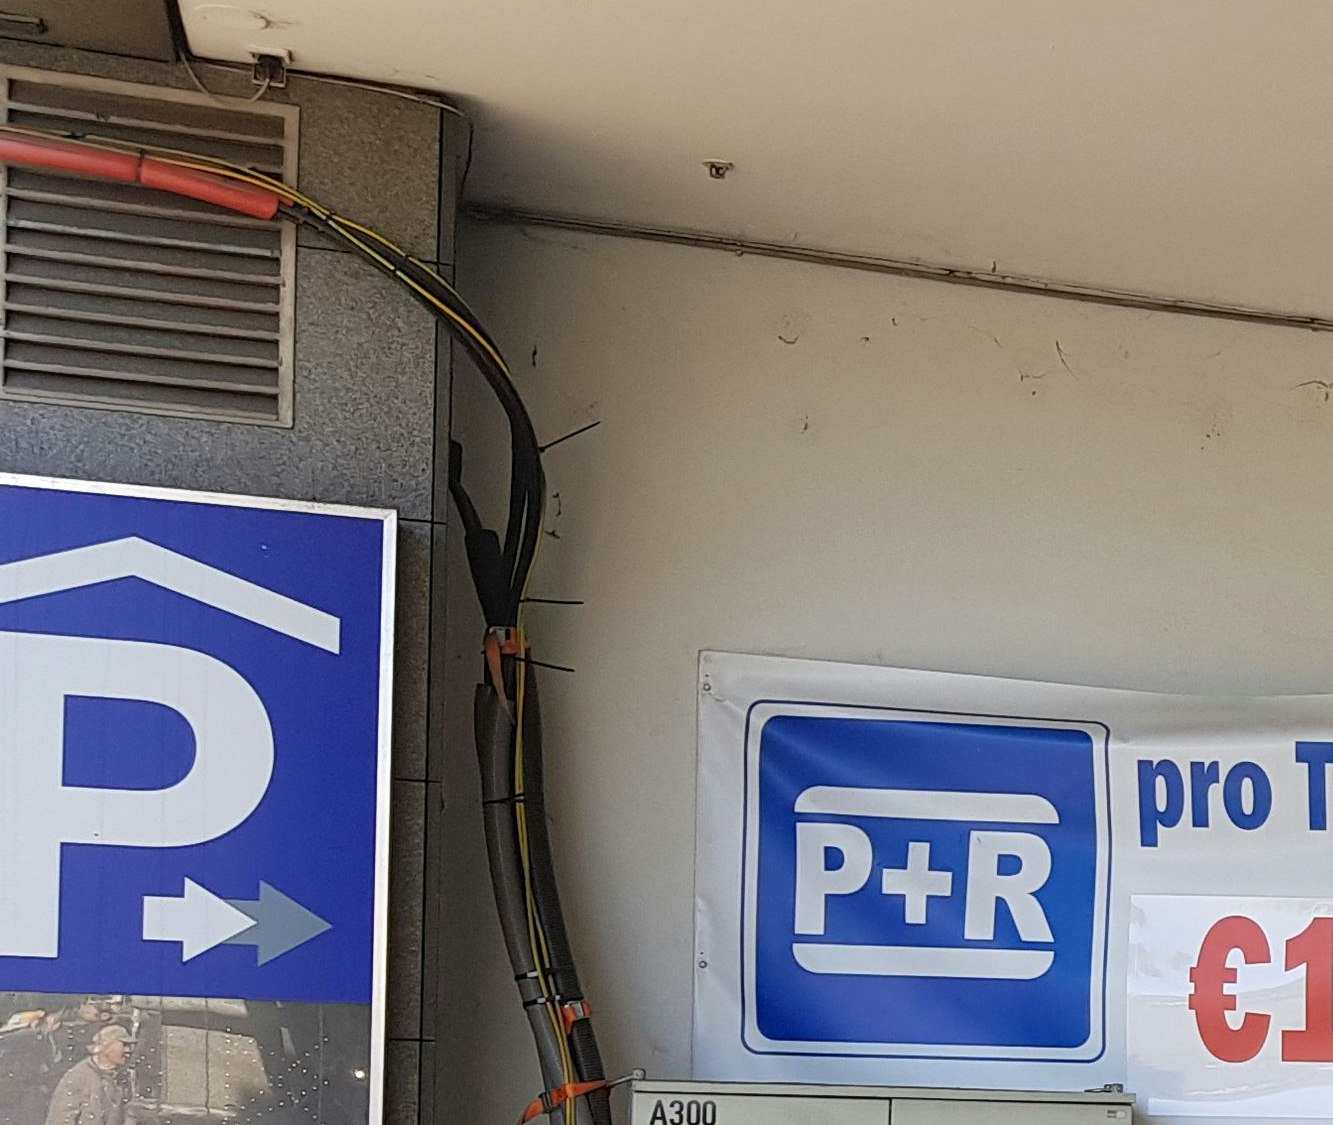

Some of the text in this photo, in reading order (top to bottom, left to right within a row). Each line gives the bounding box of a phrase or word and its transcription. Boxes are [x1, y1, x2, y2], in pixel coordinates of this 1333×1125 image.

[0, 631, 276, 959] P
[1137, 757, 1273, 848] pro
[793, 822, 1055, 944] P+R
